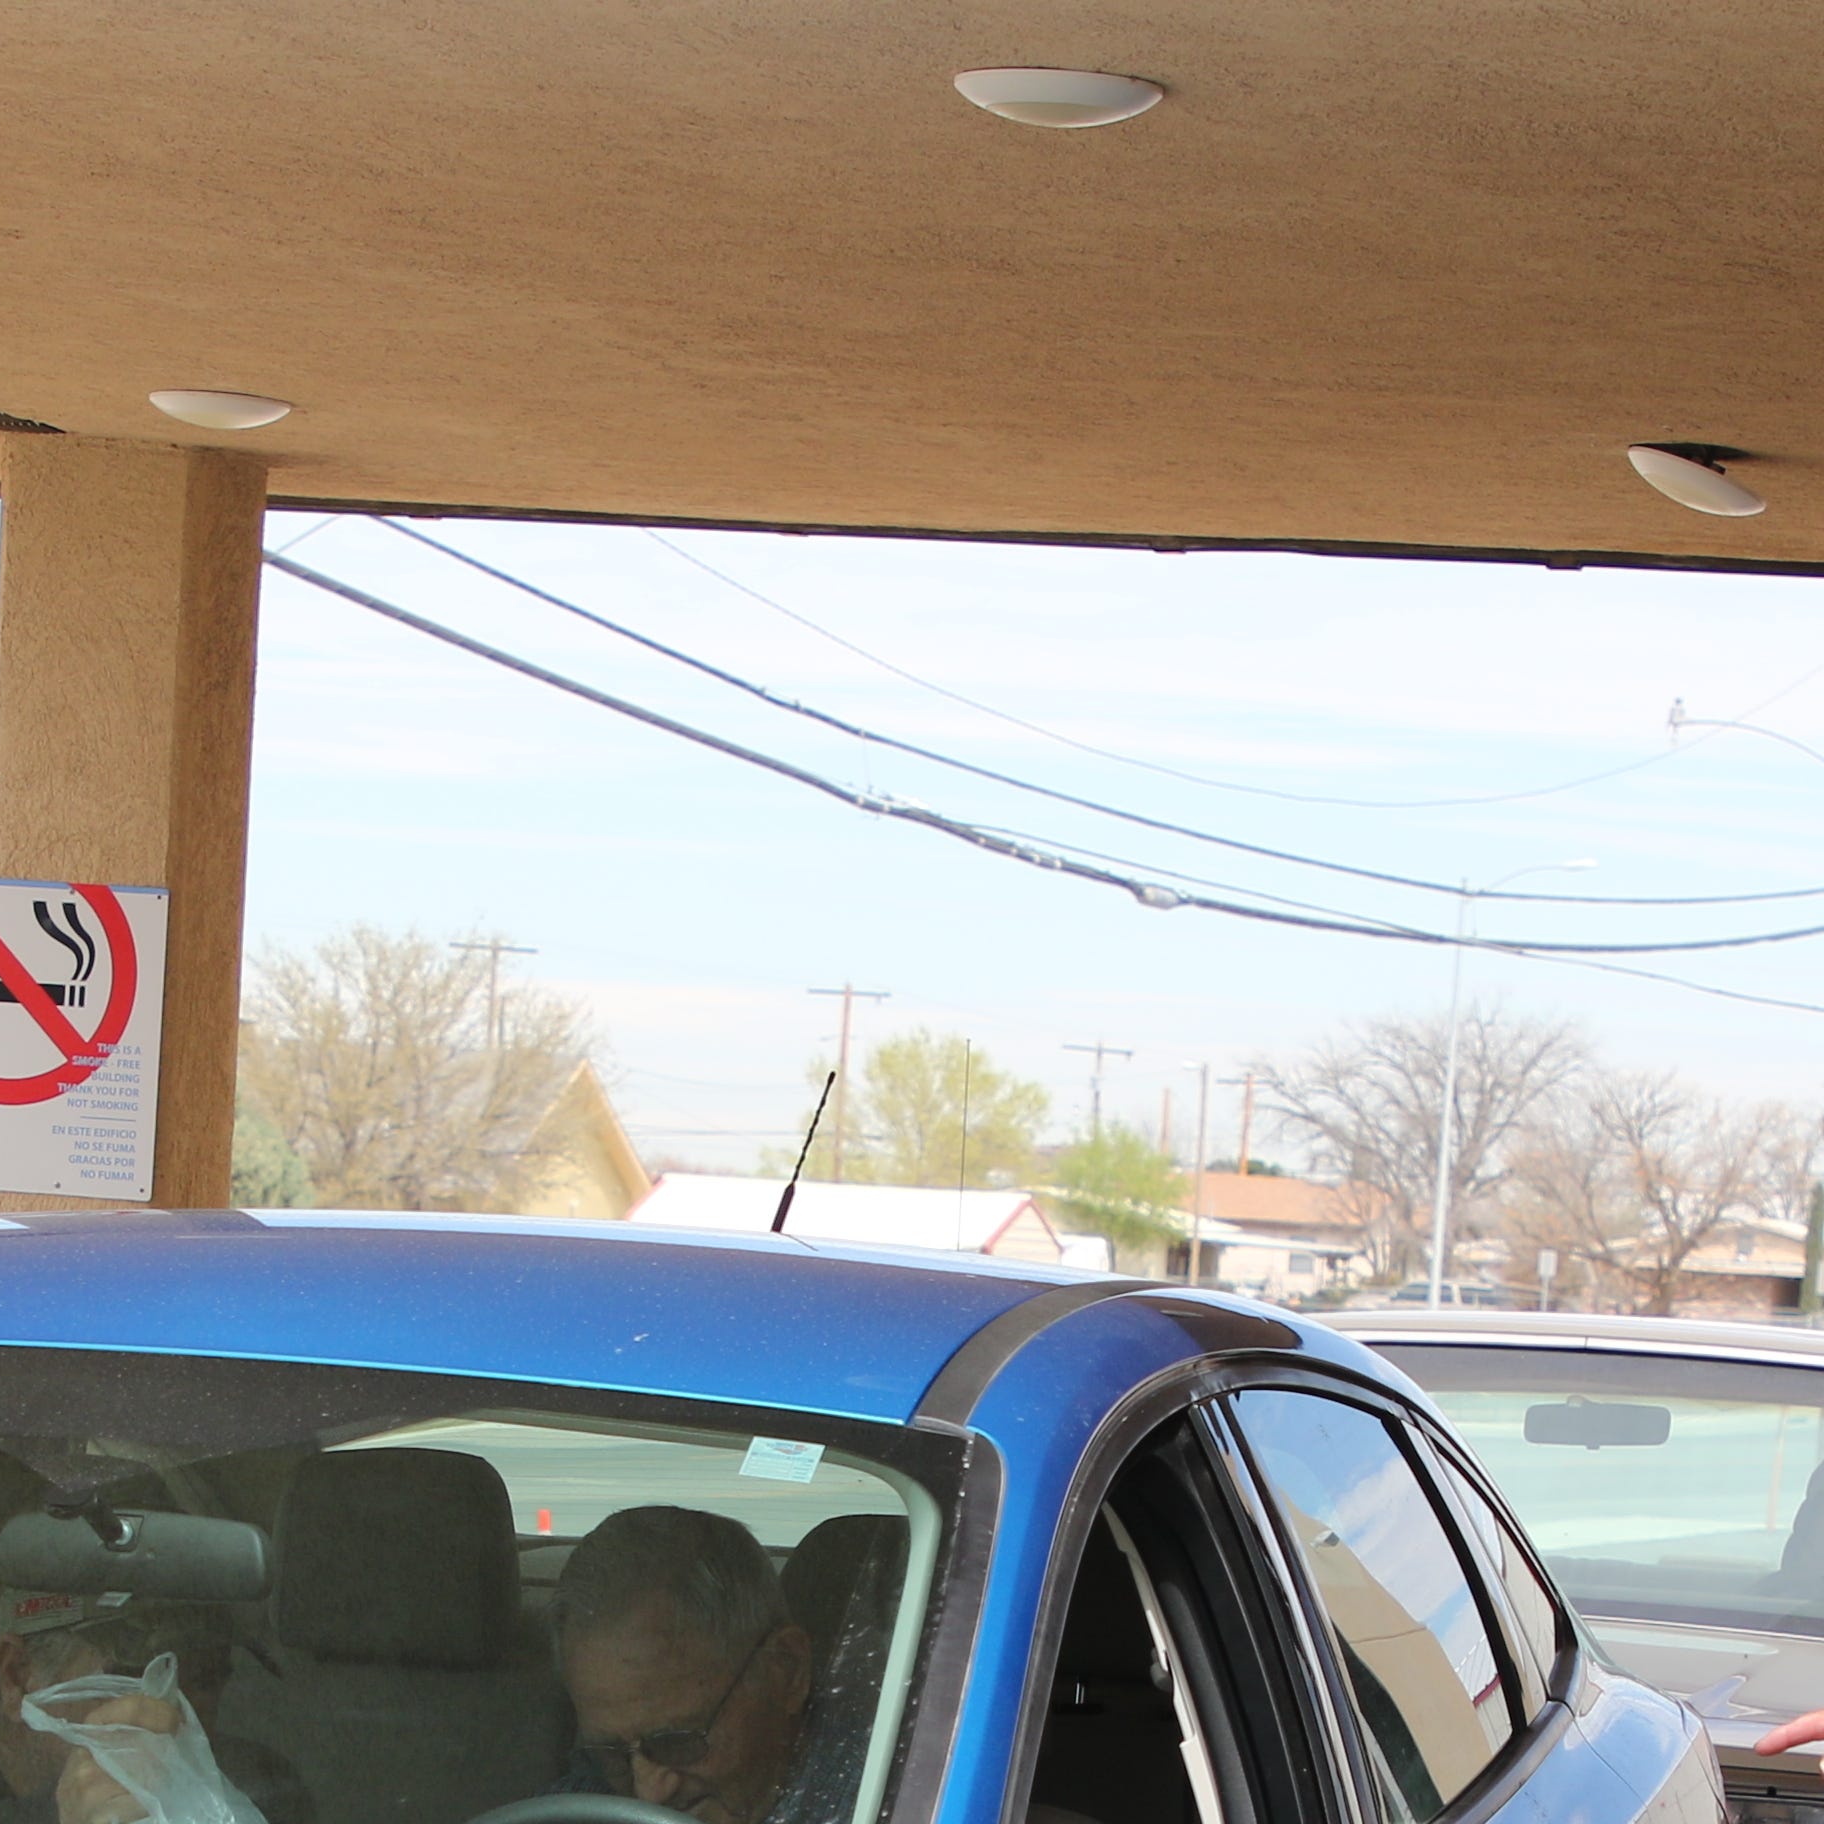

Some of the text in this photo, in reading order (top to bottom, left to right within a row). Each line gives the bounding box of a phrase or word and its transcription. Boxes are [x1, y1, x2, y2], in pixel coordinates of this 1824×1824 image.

[97, 1042, 141, 1055] THIS IS A
[72, 1055, 108, 1067] SMOKE
[117, 1059, 141, 1069] FREE
[91, 1071, 140, 1084] BUILDING
[57, 1082, 140, 1097] THANK YOU FOR
[67, 1098, 138, 1112] NOT SMOKING
[52, 1125, 137, 1139] EN ESTE EDIFICIO
[74, 1140, 136, 1153] NO SE FUMA
[68, 1154, 135, 1167] GRACIAS POR
[80, 1169, 135, 1182] NO FUMAR
